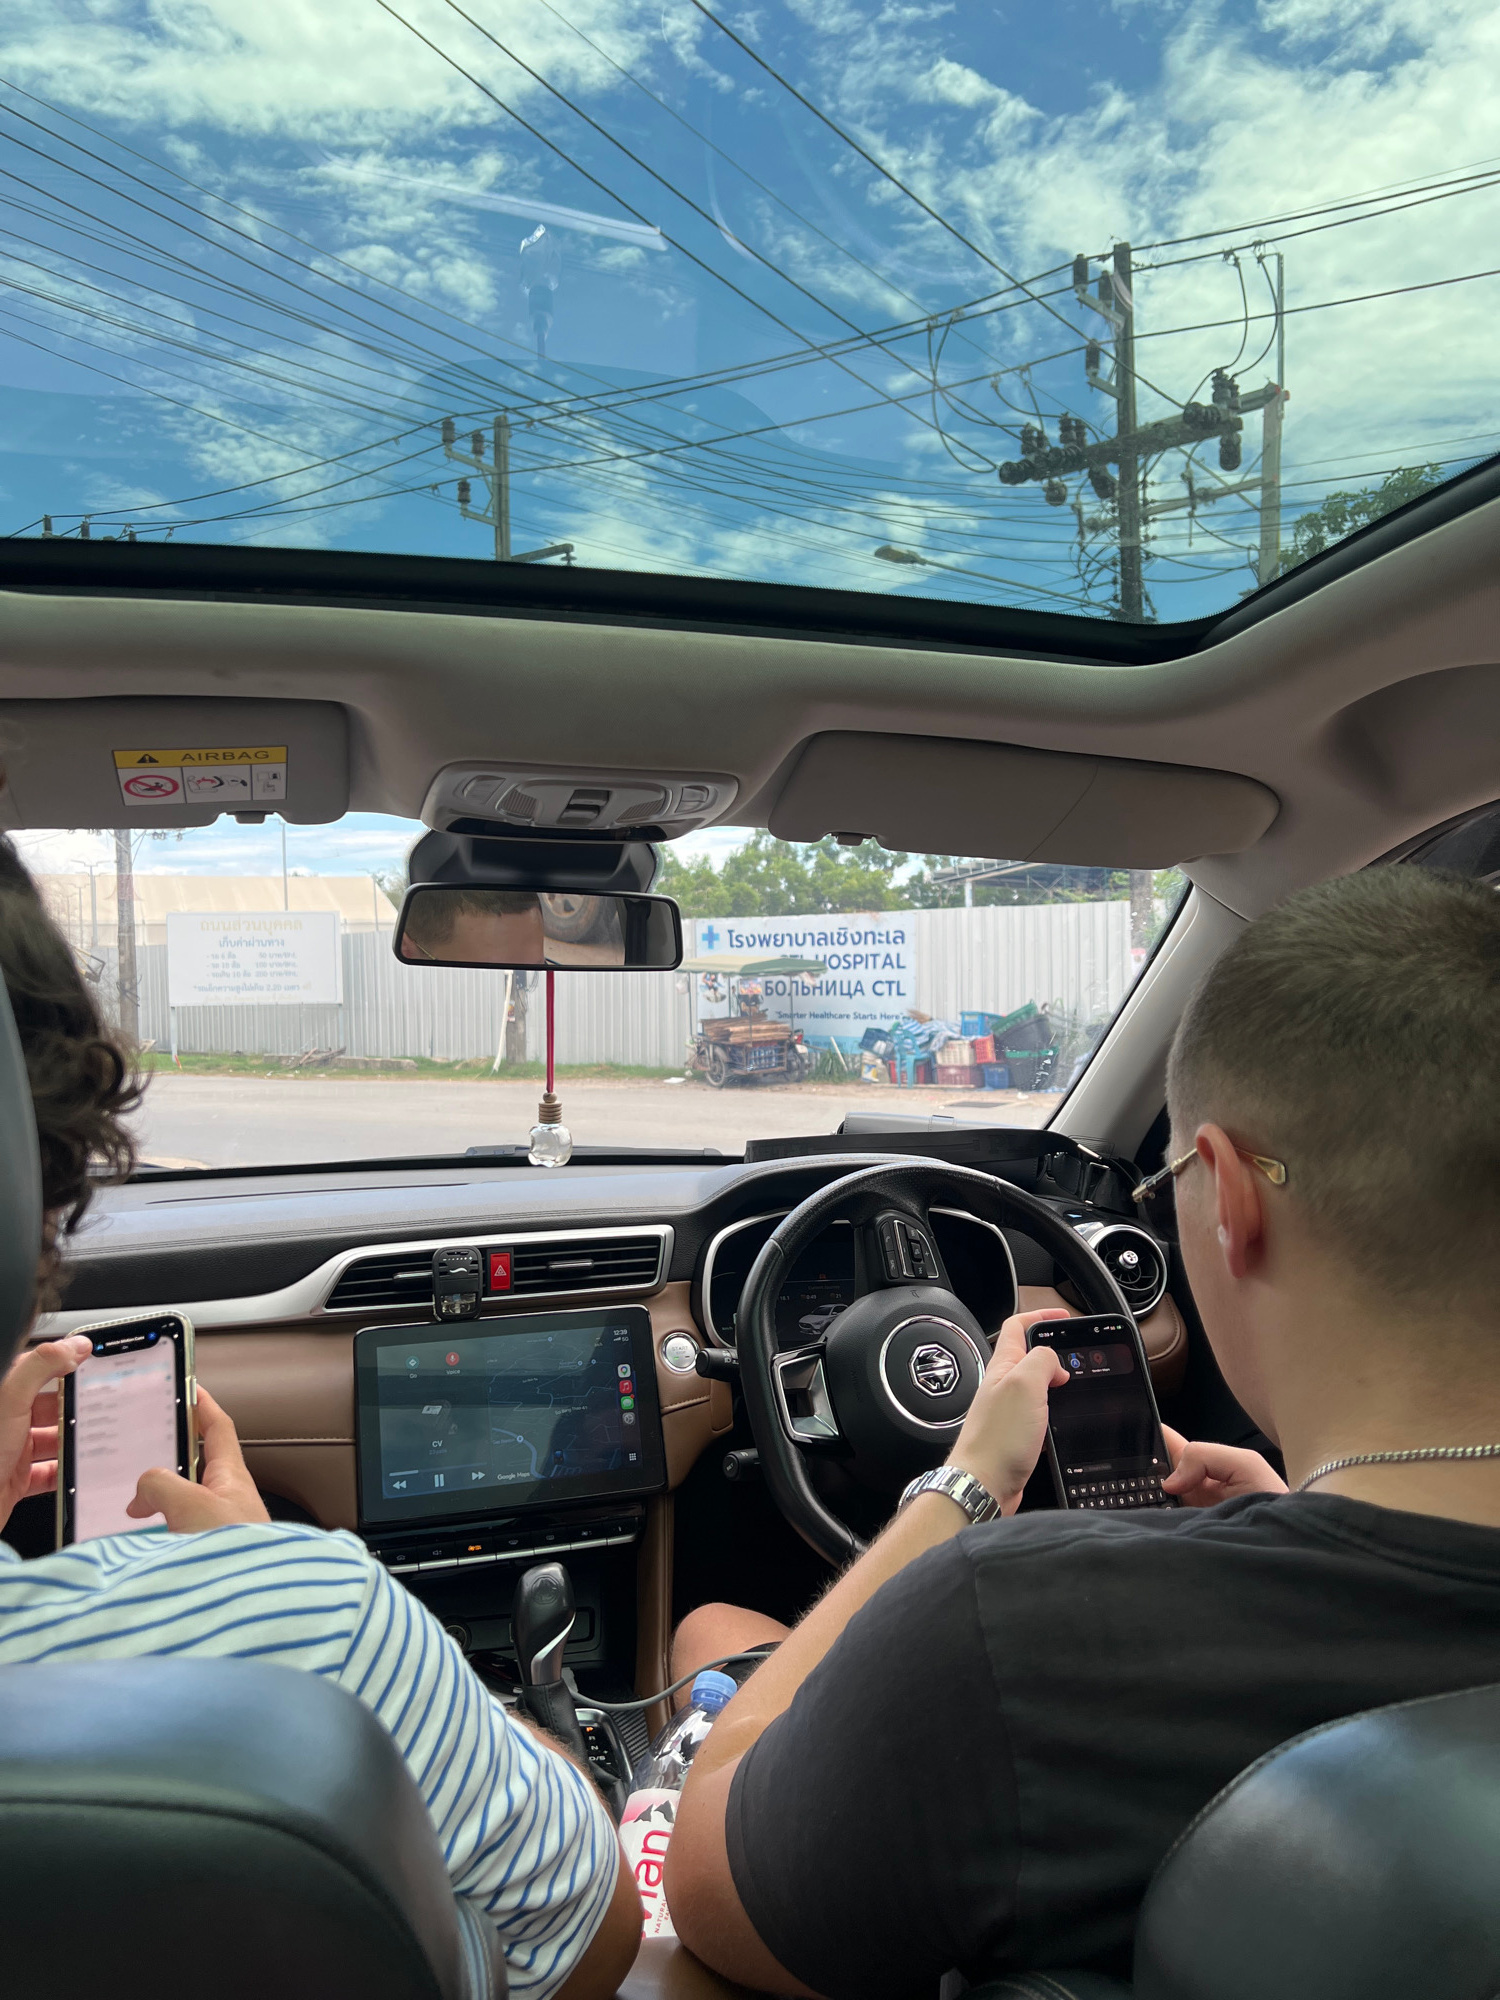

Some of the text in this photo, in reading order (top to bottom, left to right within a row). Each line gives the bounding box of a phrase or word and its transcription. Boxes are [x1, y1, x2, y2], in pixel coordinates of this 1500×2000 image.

[181, 750, 270, 762] AIRBAG
[727, 927, 906, 949] โรงพยาบาลเชิงทะเล
[765, 979, 906, 999] БОЛЬНИЦА CTL
[809, 1010, 850, 1020] Healthcare
[853, 1011, 877, 1020] Starts
[914, 1346, 956, 1392] MG
[497, 1472, 516, 1480] Google
